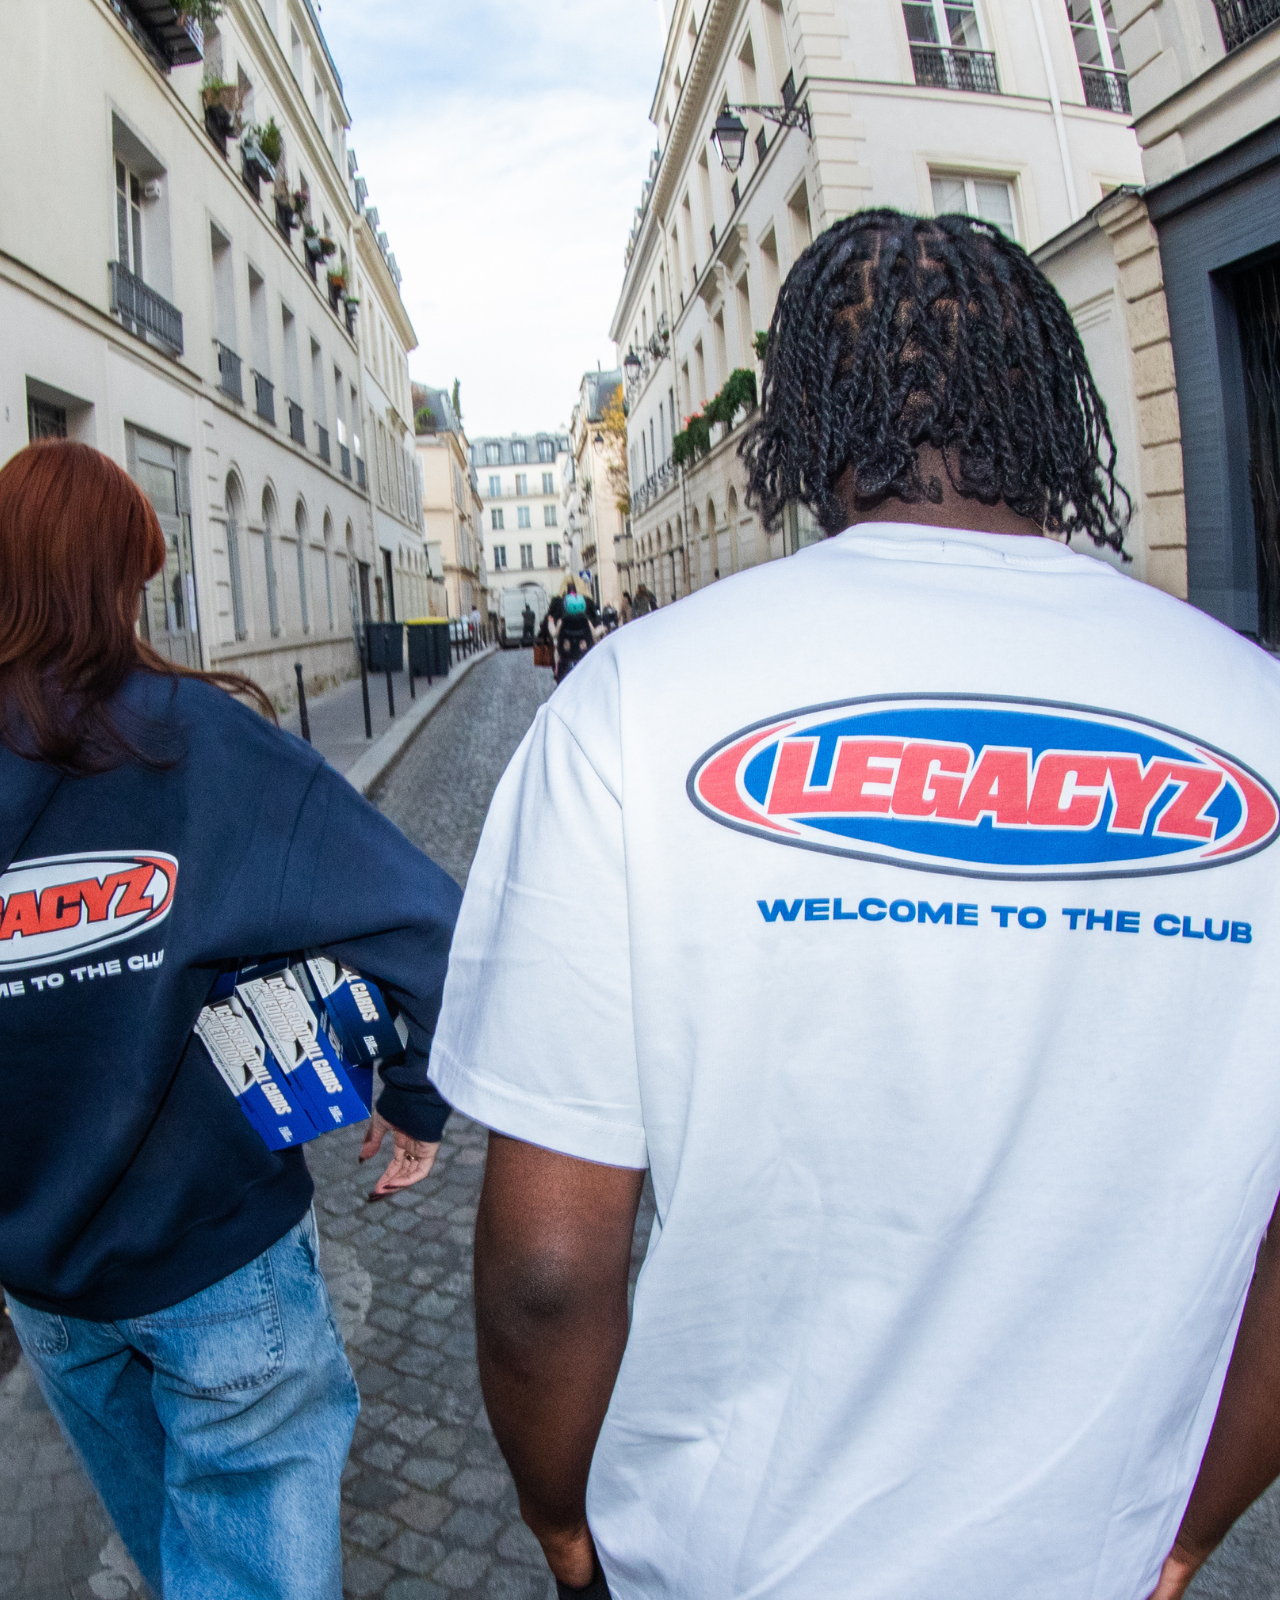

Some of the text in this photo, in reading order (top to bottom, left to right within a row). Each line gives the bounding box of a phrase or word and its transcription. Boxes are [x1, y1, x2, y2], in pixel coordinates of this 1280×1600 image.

[766, 739, 1225, 841] LEGACYZ
[0, 865, 156, 941] ACYZ
[756, 897, 1253, 945] WELCOME TO THE CLUB
[30, 973, 65, 992] TO
[70, 959, 122, 983] THE
[127, 948, 164, 972] CLU
[261, 999, 297, 1040] EDITION
[348, 981, 380, 1023] CARDS
[208, 1026, 245, 1066] EDITION
[266, 976, 297, 1011] ICONS
[284, 1009, 324, 1061] FOOTBALL
[311, 1057, 344, 1095] CARDS
[213, 1004, 246, 1038] ICONS
[232, 1035, 273, 1084] FOOTBALL
[260, 1080, 293, 1116] CARDS
